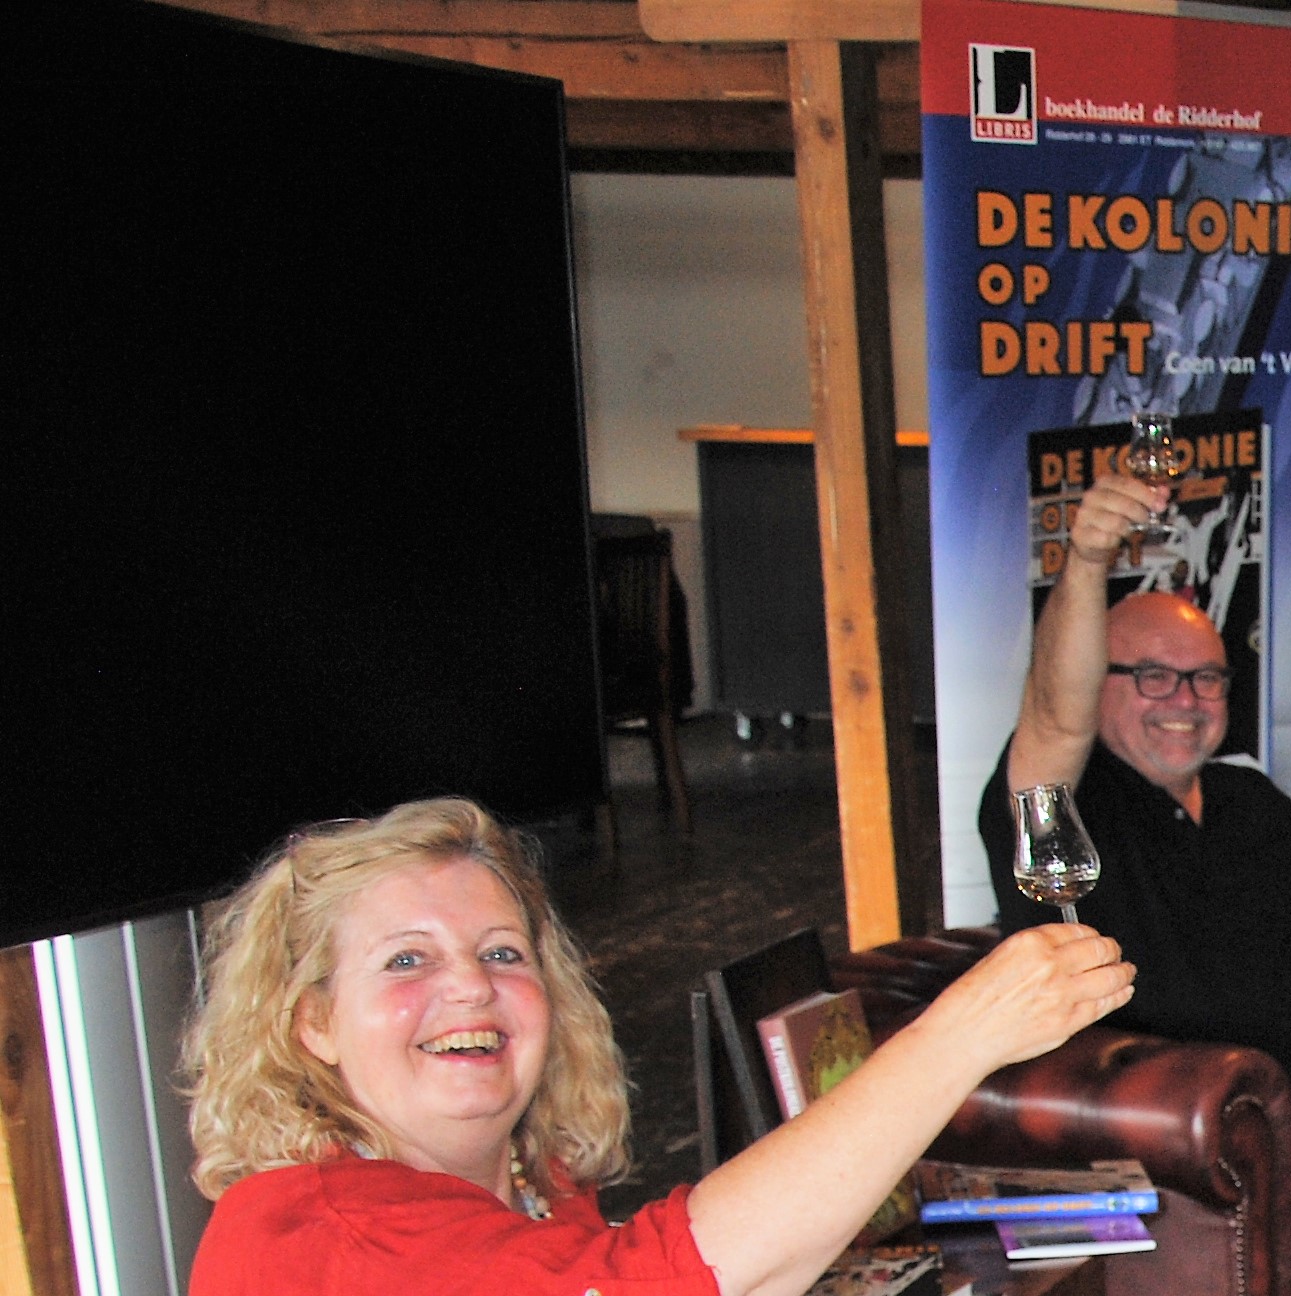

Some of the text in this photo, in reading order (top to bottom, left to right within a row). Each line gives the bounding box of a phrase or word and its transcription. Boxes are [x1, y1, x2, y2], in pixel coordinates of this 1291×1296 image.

[976, 120, 1032, 140] LIBRIS
[1045, 97, 1263, 130] boekhandel de Ridderhof
[976, 190, 1053, 249] DE
[977, 262, 1051, 305] OP
[979, 320, 1152, 376] DRIFT
[1165, 352, 1215, 373] Coen
[1220, 358, 1255, 373] van
[1041, 430, 1258, 488] DE KONIE
